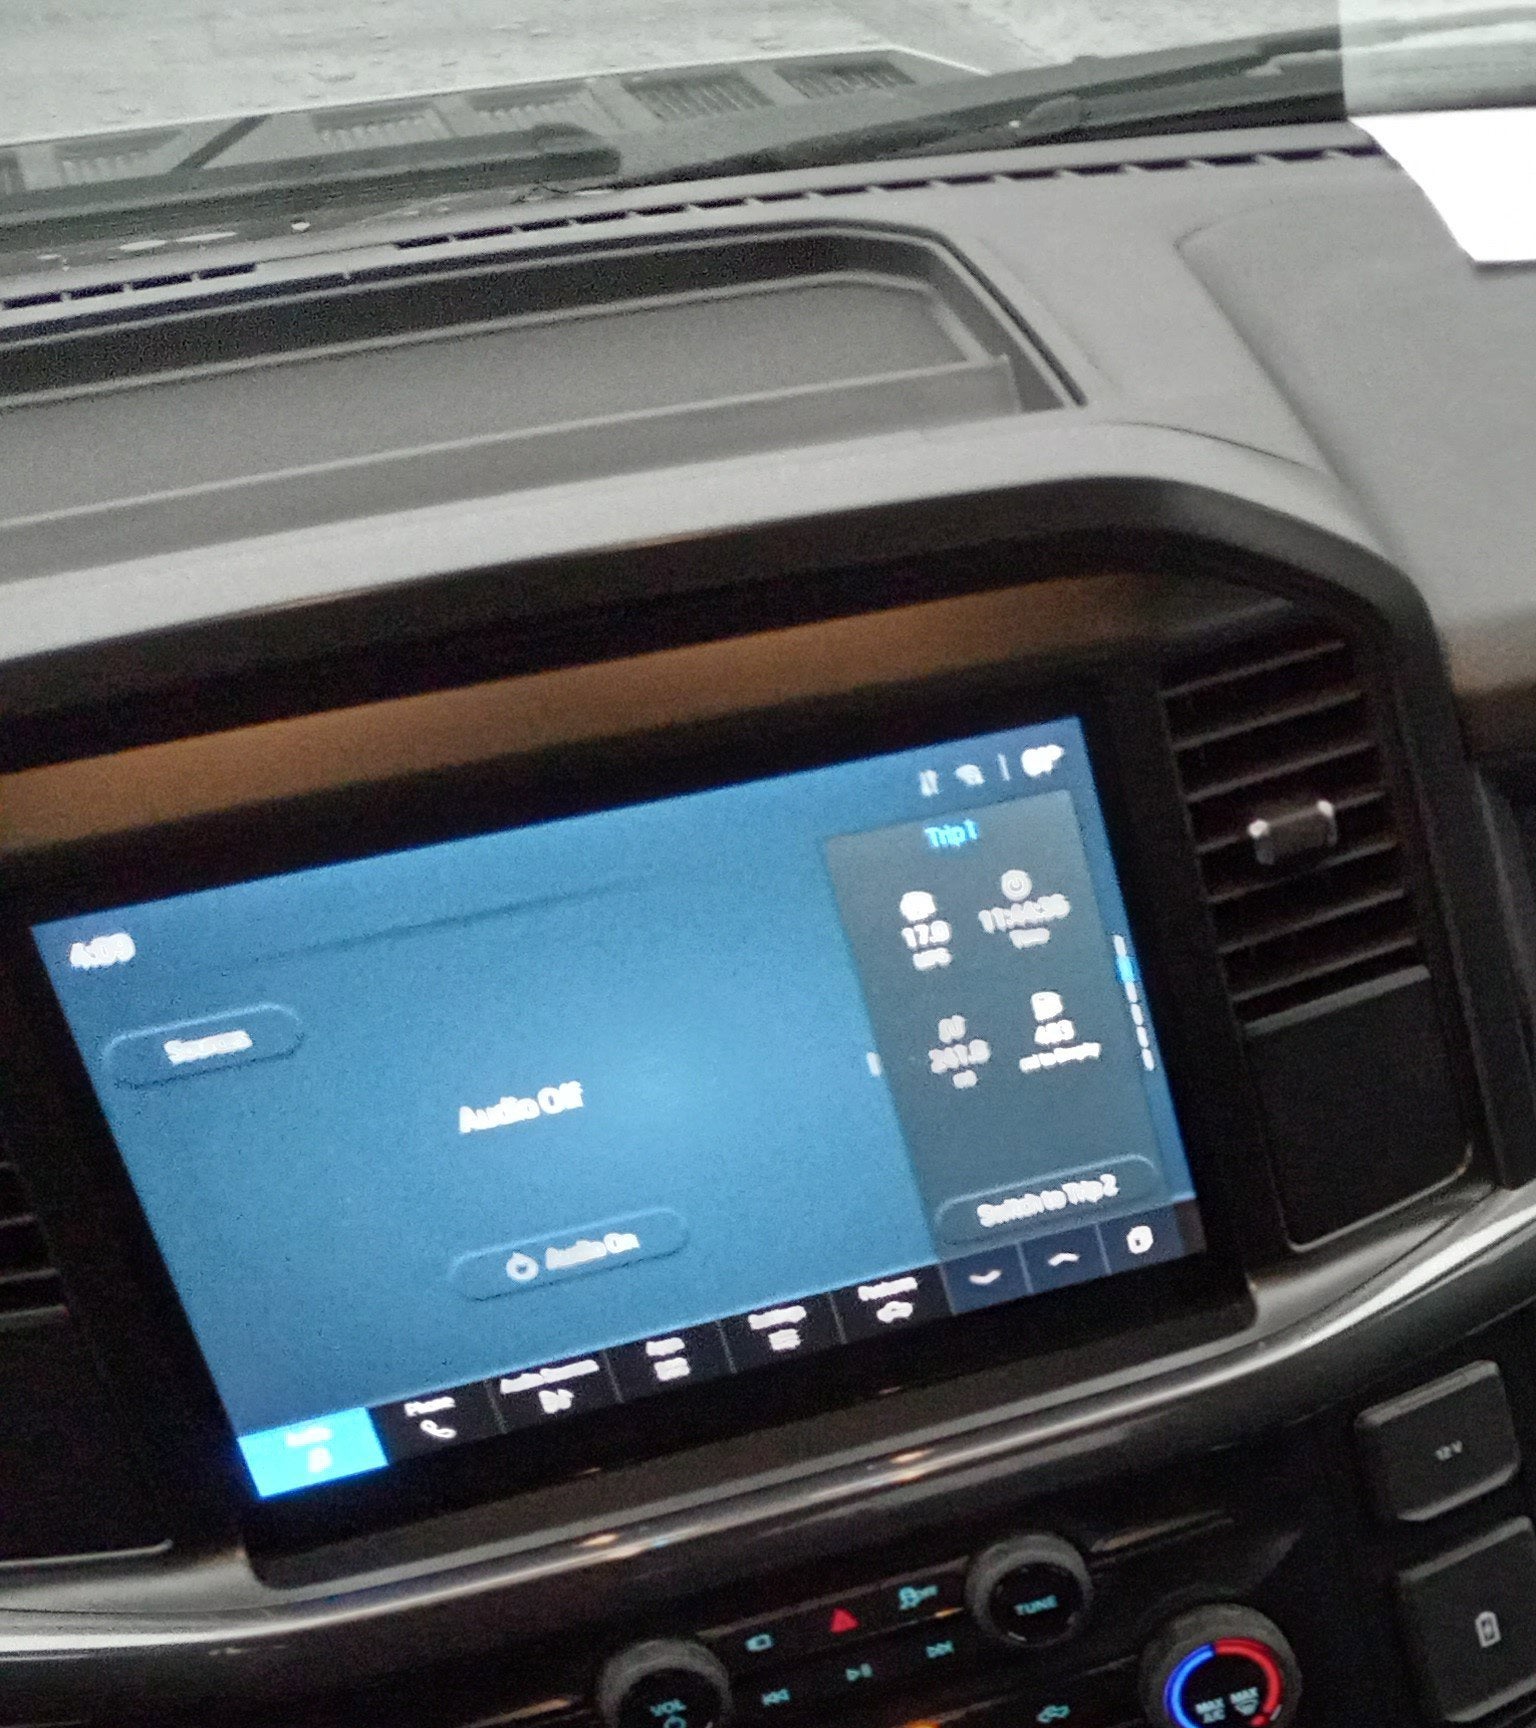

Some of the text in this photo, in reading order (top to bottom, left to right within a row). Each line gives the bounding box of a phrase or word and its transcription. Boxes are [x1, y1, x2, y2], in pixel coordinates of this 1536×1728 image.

[459, 1097, 541, 1133] Audio
[1013, 1594, 1058, 1616] TUNE
[1230, 1686, 1259, 1705] MAX
[650, 1698, 687, 1717] VOL
[1195, 1696, 1225, 1715] MAX
[1203, 1708, 1226, 1724] A/C
